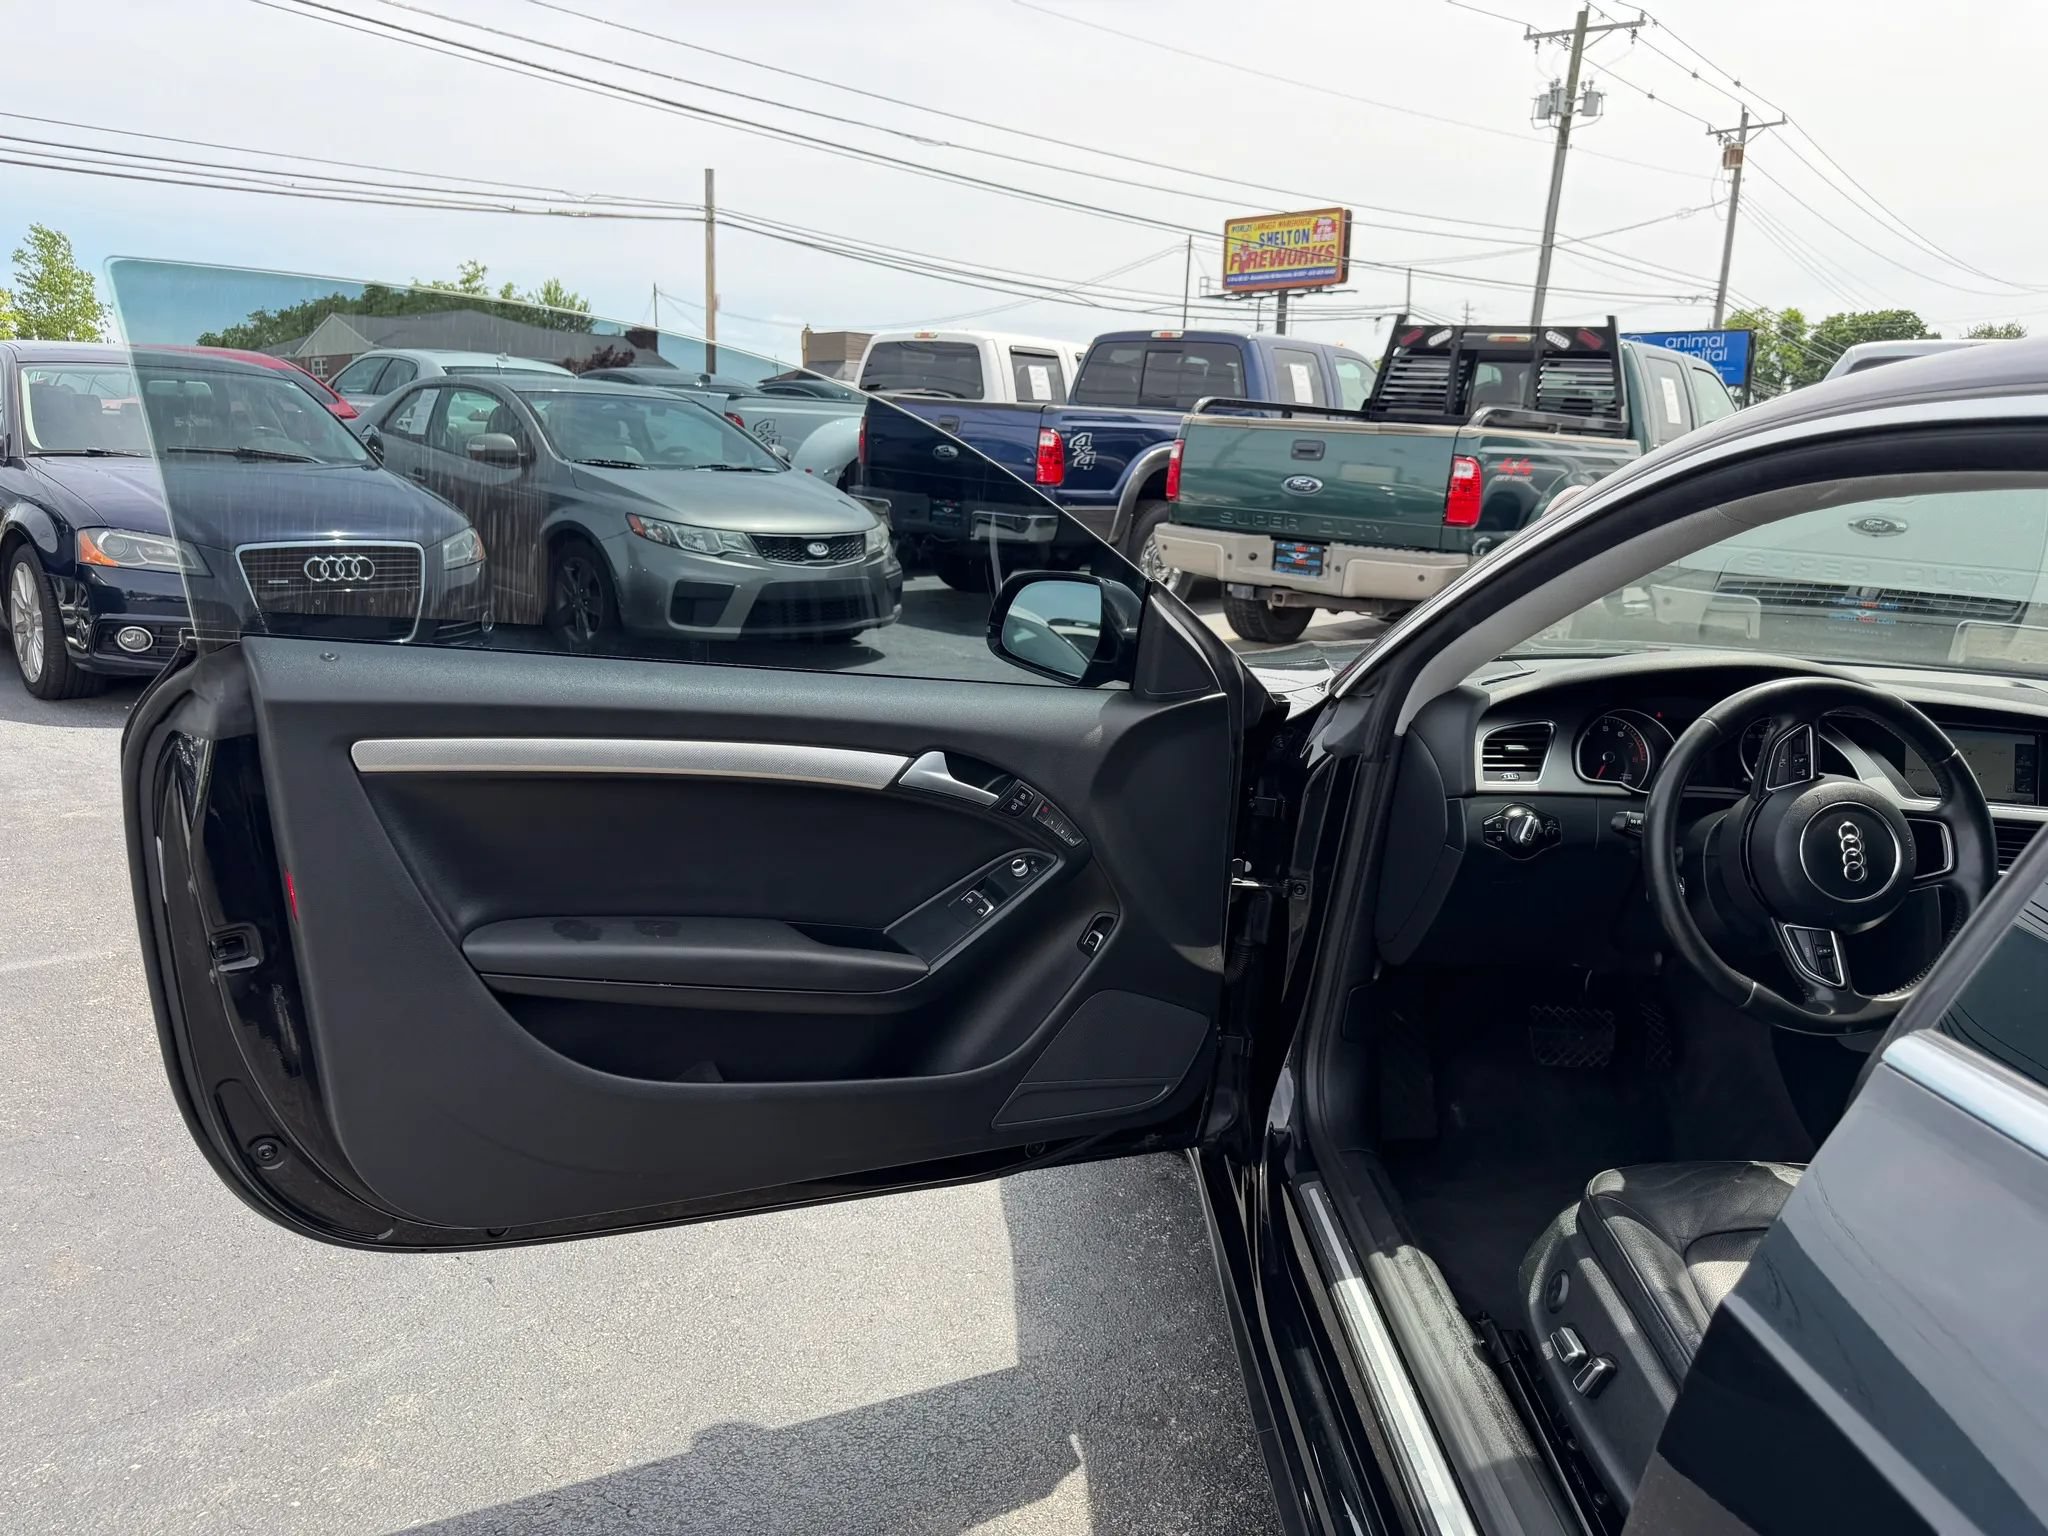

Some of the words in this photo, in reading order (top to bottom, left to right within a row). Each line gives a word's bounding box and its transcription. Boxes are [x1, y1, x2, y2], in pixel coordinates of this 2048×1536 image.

[1259, 229, 1310, 248] SHELTON
[1230, 244, 1336, 272] FIREWORKS
[1665, 334, 1725, 348] animal
[1219, 511, 1300, 531] SUPER
[1743, 555, 1871, 581] SUPER
